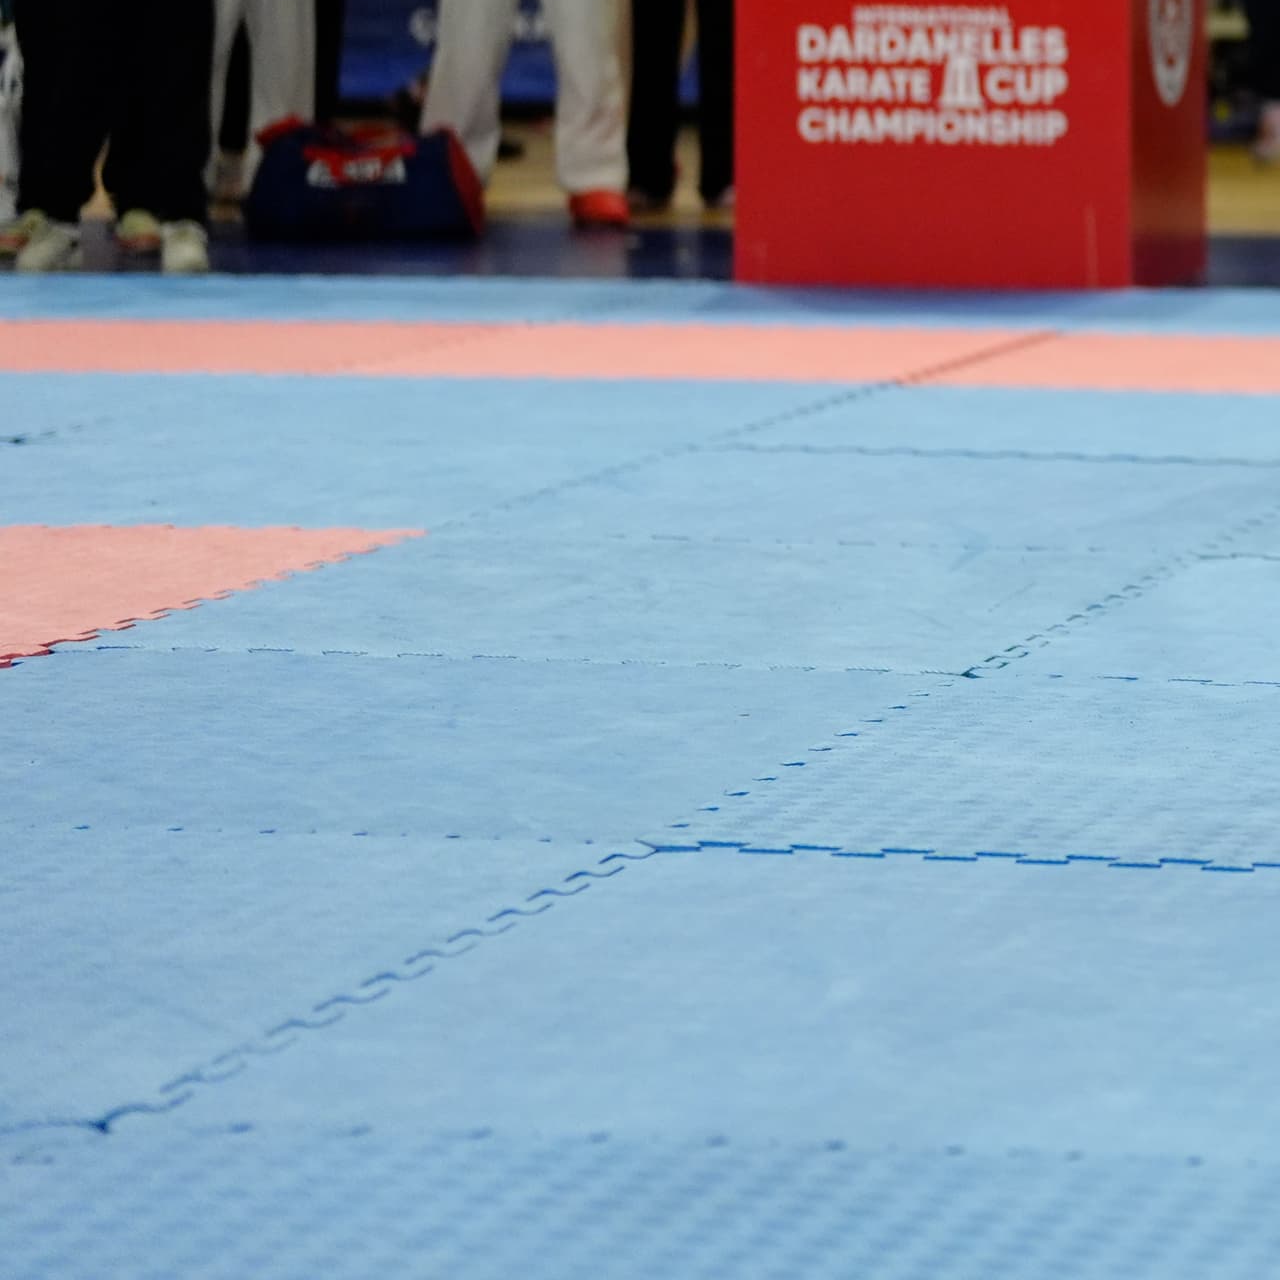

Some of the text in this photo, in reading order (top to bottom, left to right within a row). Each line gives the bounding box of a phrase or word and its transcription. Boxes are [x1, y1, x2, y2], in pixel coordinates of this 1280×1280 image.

[797, 24, 1068, 65] DARDANELLES
[798, 66, 1068, 105] KARATE CUP
[797, 106, 1068, 145] CHAMPIONSHIP
